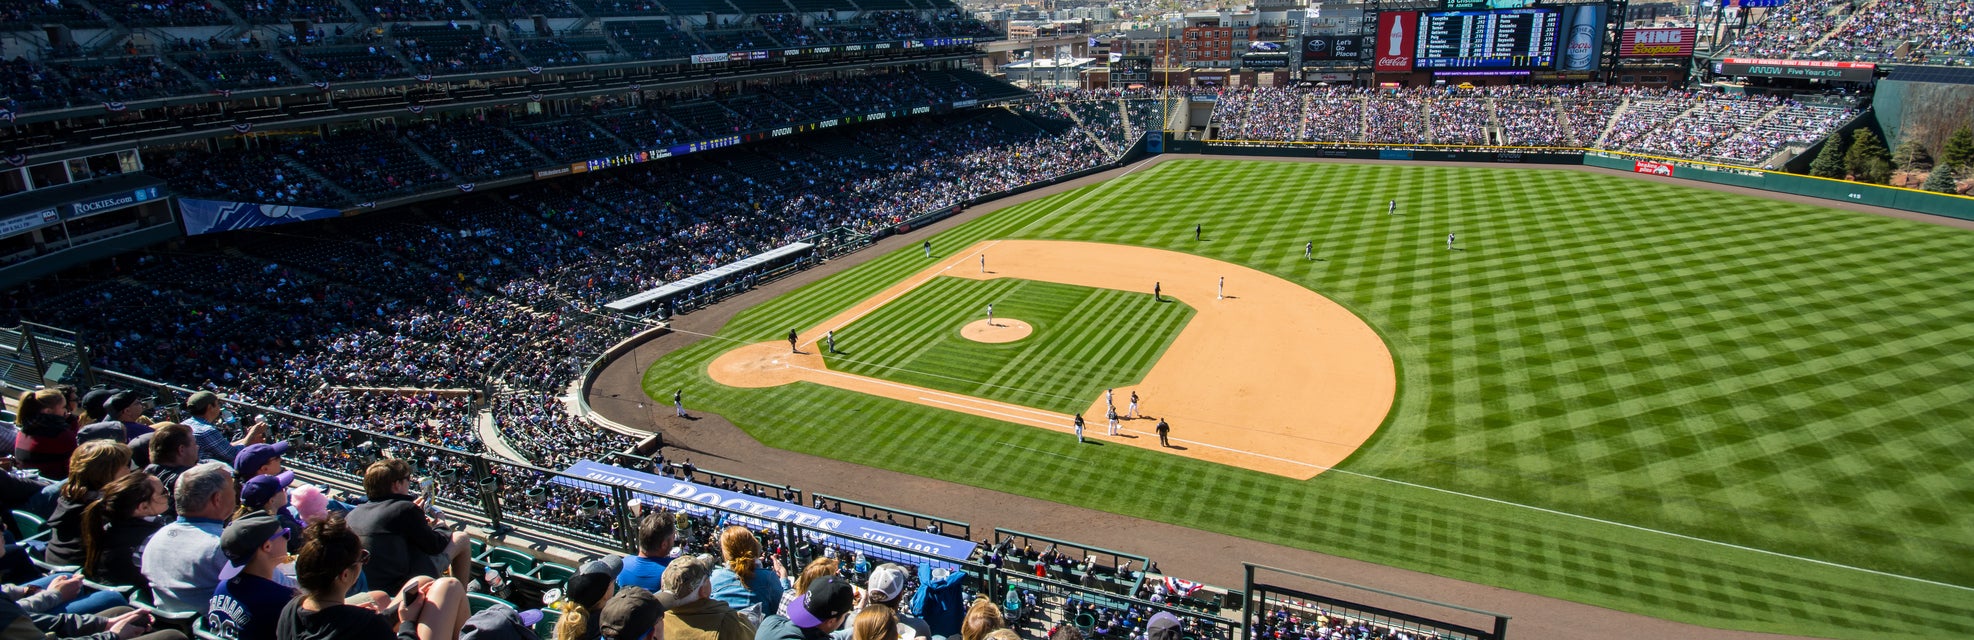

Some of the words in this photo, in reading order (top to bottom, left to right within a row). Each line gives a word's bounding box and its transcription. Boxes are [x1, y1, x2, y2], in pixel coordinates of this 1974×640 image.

[1634, 30, 1682, 43] KING
[1378, 56, 1408, 66] Coca-Cola
[1804, 68, 1826, 76] Years
[655, 482, 842, 540] ROCKIES
[862, 532, 902, 546] SINCE
[208, 594, 250, 626] RENADO
